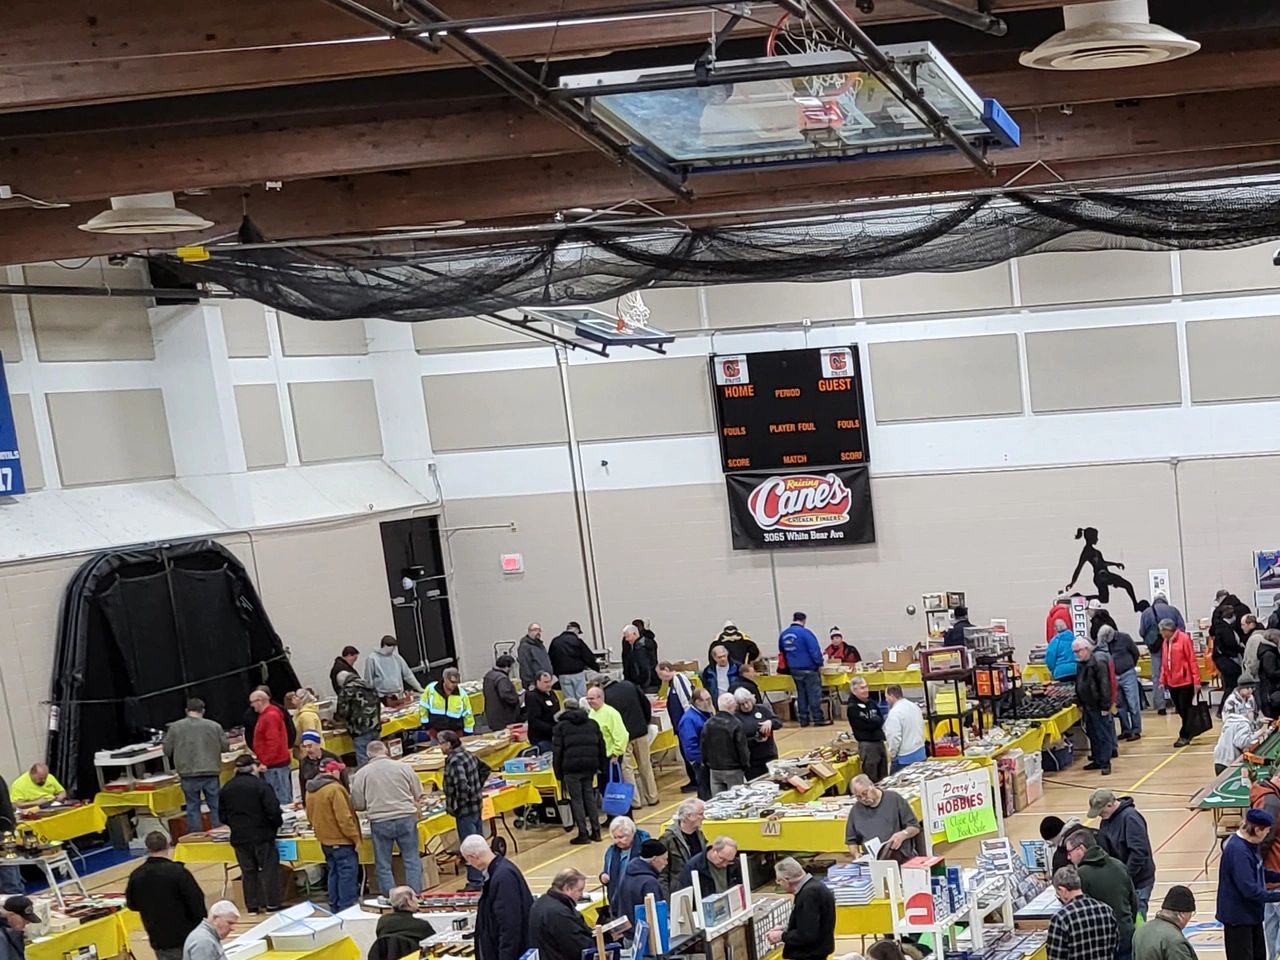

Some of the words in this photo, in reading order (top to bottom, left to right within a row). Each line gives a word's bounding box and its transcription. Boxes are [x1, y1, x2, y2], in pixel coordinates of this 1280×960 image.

[818, 378, 851, 391] GUEST
[724, 385, 754, 398] HOME
[774, 388, 800, 398] PERIOD
[769, 424, 795, 433] PLAYER
[797, 422, 816, 432] FOUL
[837, 419, 860, 429] FOULS
[723, 427, 746, 436] FOULS
[728, 458, 750, 467] SCORE
[783, 455, 807, 464] MATCH
[787, 478, 820, 490] Raising
[756, 474, 848, 527] Cane's
[763, 532, 785, 542] 3065
[786, 531, 809, 541] White
[810, 530, 828, 540] Bear
[937, 792, 984, 816] HOBBIES
